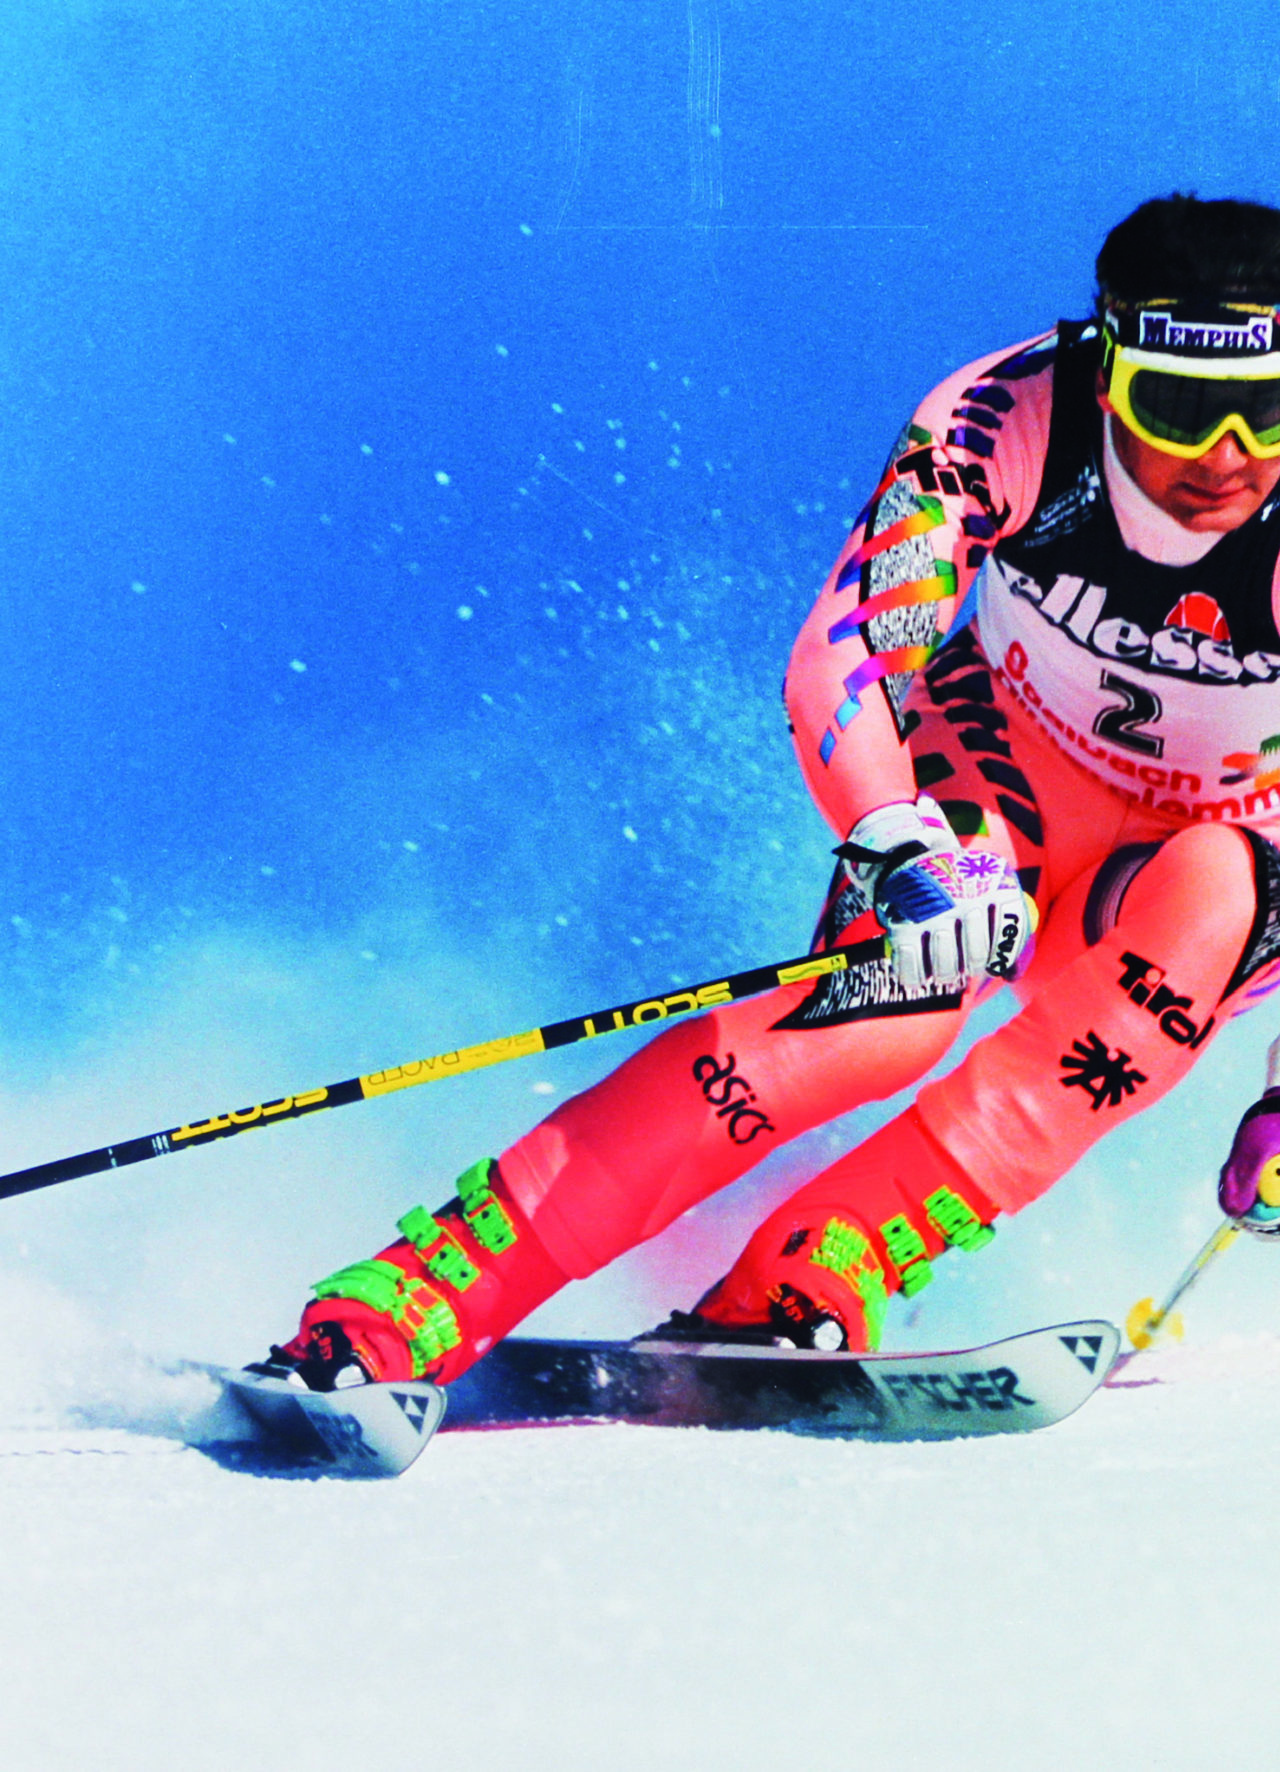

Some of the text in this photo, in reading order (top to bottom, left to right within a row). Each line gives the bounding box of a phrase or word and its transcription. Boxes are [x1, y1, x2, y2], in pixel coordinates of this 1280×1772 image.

[1140, 313, 1272, 350] MEMPHIS
[1092, 668, 1164, 759] 2
[577, 981, 734, 1042] SCOTT
[692, 1051, 775, 1145] asics
